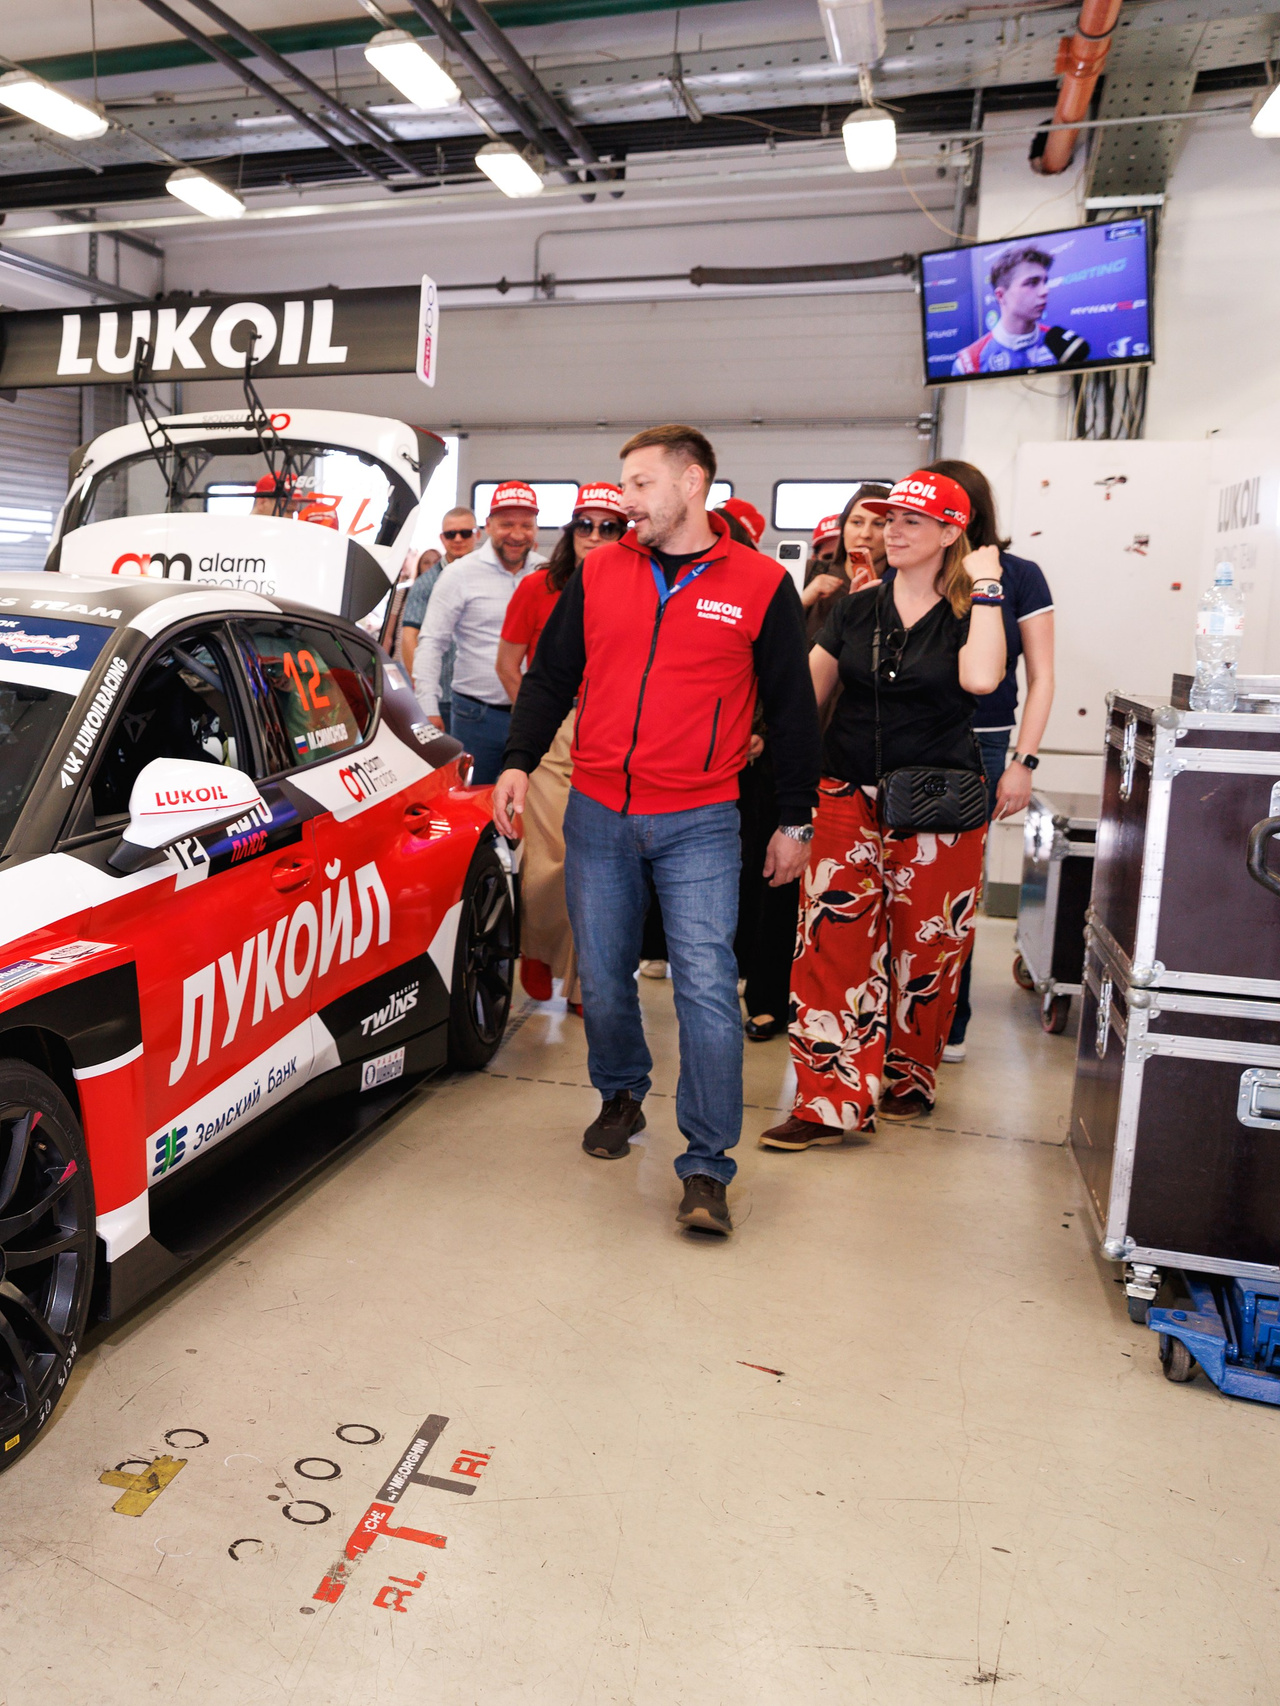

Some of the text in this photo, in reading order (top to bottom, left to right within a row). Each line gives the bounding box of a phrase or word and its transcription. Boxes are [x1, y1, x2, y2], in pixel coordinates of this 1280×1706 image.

[57, 298, 348, 375] LUKOIL
[496, 488, 535, 500] LUKOIL
[582, 488, 623, 502] LUKO
[888, 480, 937, 501] UKOIL
[1217, 476, 1261, 533] LUKOIL
[199, 552, 266, 573] alarm
[30, 600, 123, 620] TEAM
[696, 598, 743, 619] LUKOIL
[283, 649, 331, 712] 12
[73, 656, 128, 756] LUKOILRACING
[155, 785, 228, 807] LUKOIL
[339, 761, 377, 802] am
[230, 829, 269, 863] ПЛЮС
[168, 857, 391, 1087] ЛУКОЙЛ
[360, 987, 420, 1036] TWINS
[193, 1079, 261, 1150] Земский
